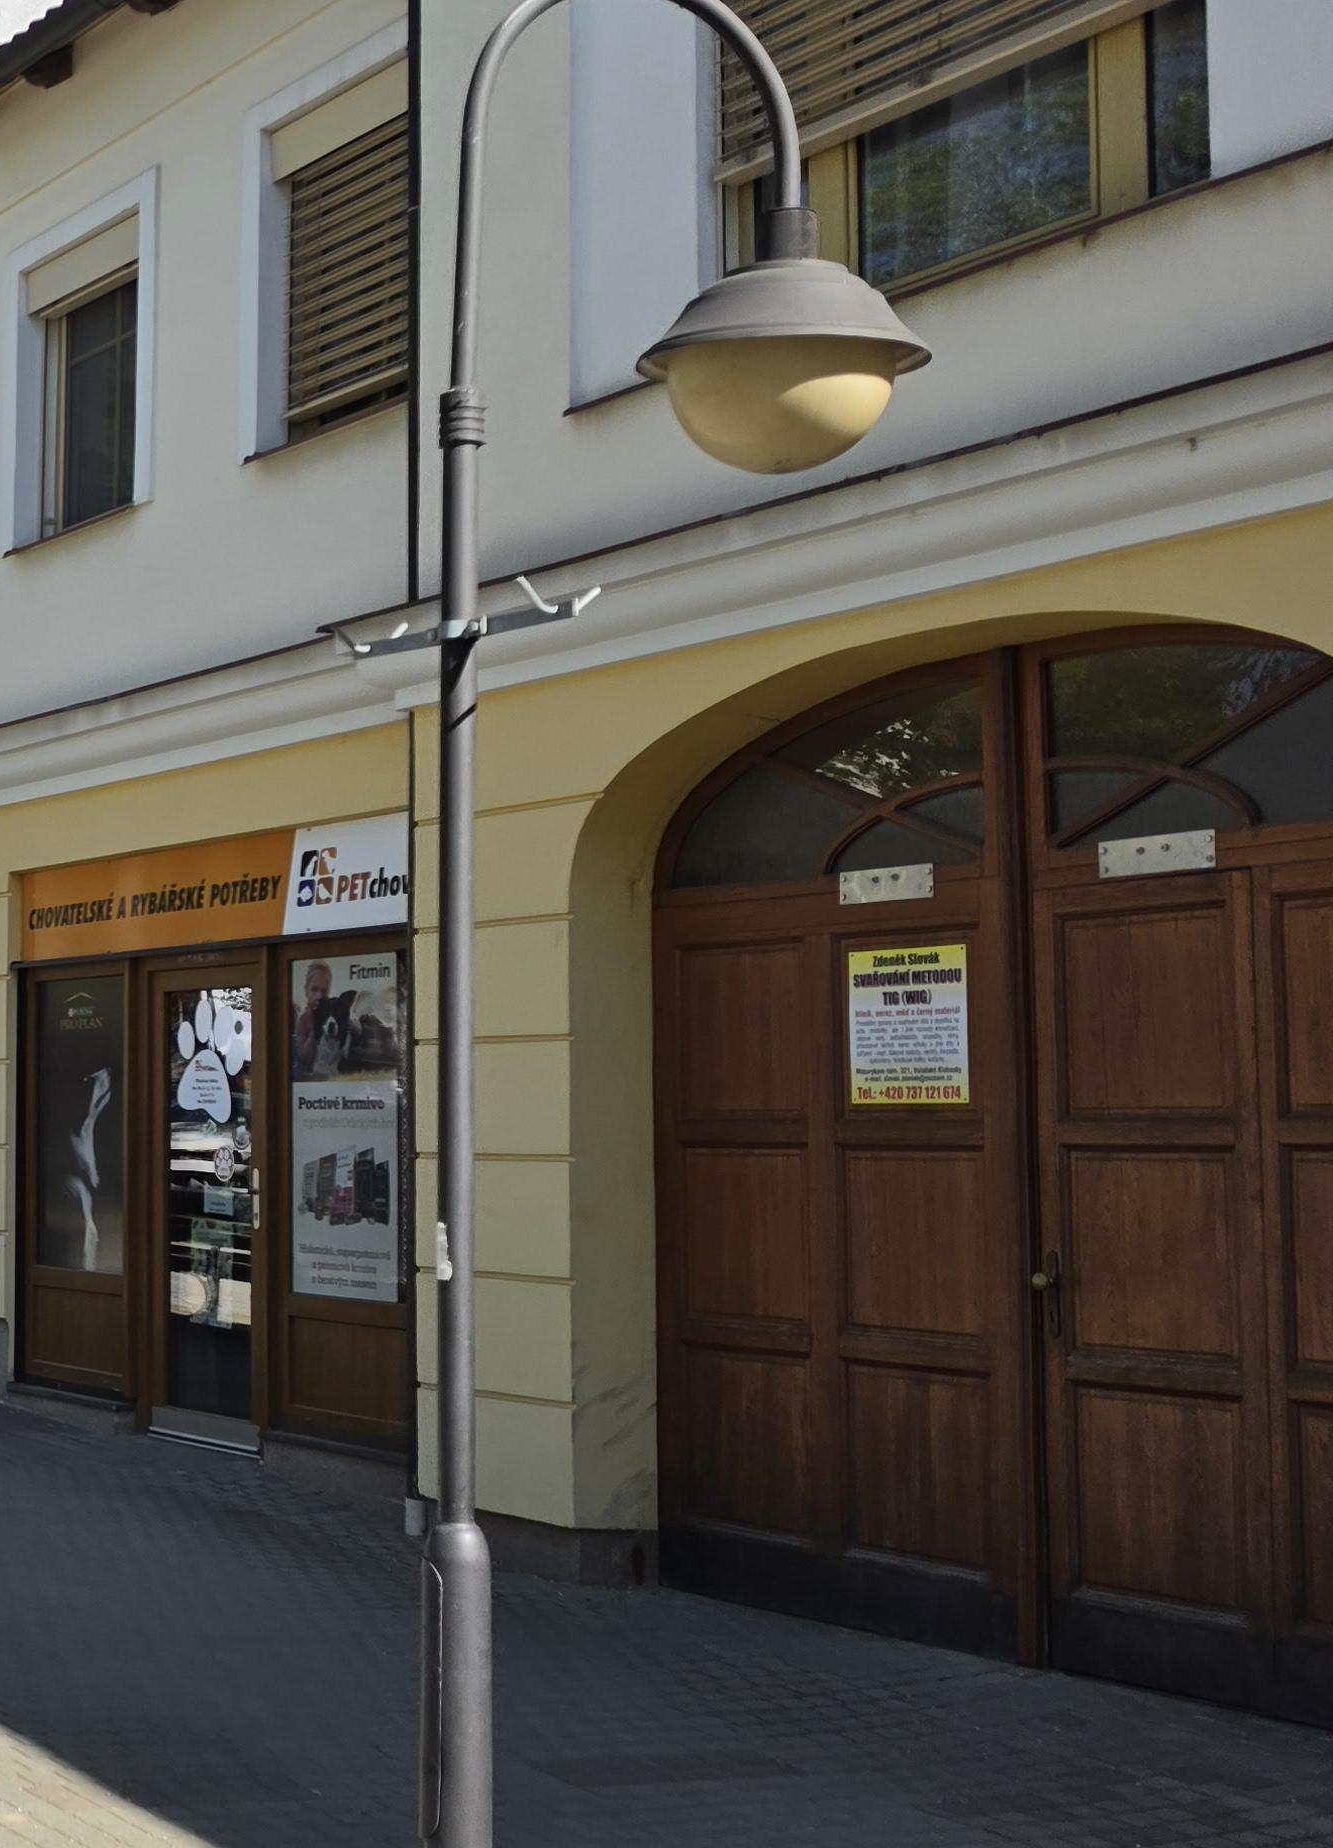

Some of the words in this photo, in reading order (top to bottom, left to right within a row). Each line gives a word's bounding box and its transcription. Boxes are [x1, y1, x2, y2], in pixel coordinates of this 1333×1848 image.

[29, 892, 114, 931] CHOVATELSKÉ
[116, 896, 126, 919] A
[130, 879, 206, 917] RYBÁŘSKÉ
[209, 873, 282, 908] POTŘEBY
[873, 953, 906, 968] Zdeněk
[907, 952, 940, 966] Slovák
[349, 962, 391, 980] Fitmin
[853, 968, 911, 988] SVAŘOVÁNÍ
[911, 968, 962, 985] METODOU
[882, 991, 900, 1006] TIG
[901, 989, 932, 1006] (WIG)
[879, 1085, 904, 1099] +420
[904, 1085, 923, 1099] 737
[924, 1085, 941, 1099] 121
[942, 1085, 961, 1099] 674
[298, 1096, 341, 1110] Poctivé
[341, 1096, 385, 1110] krmivo
